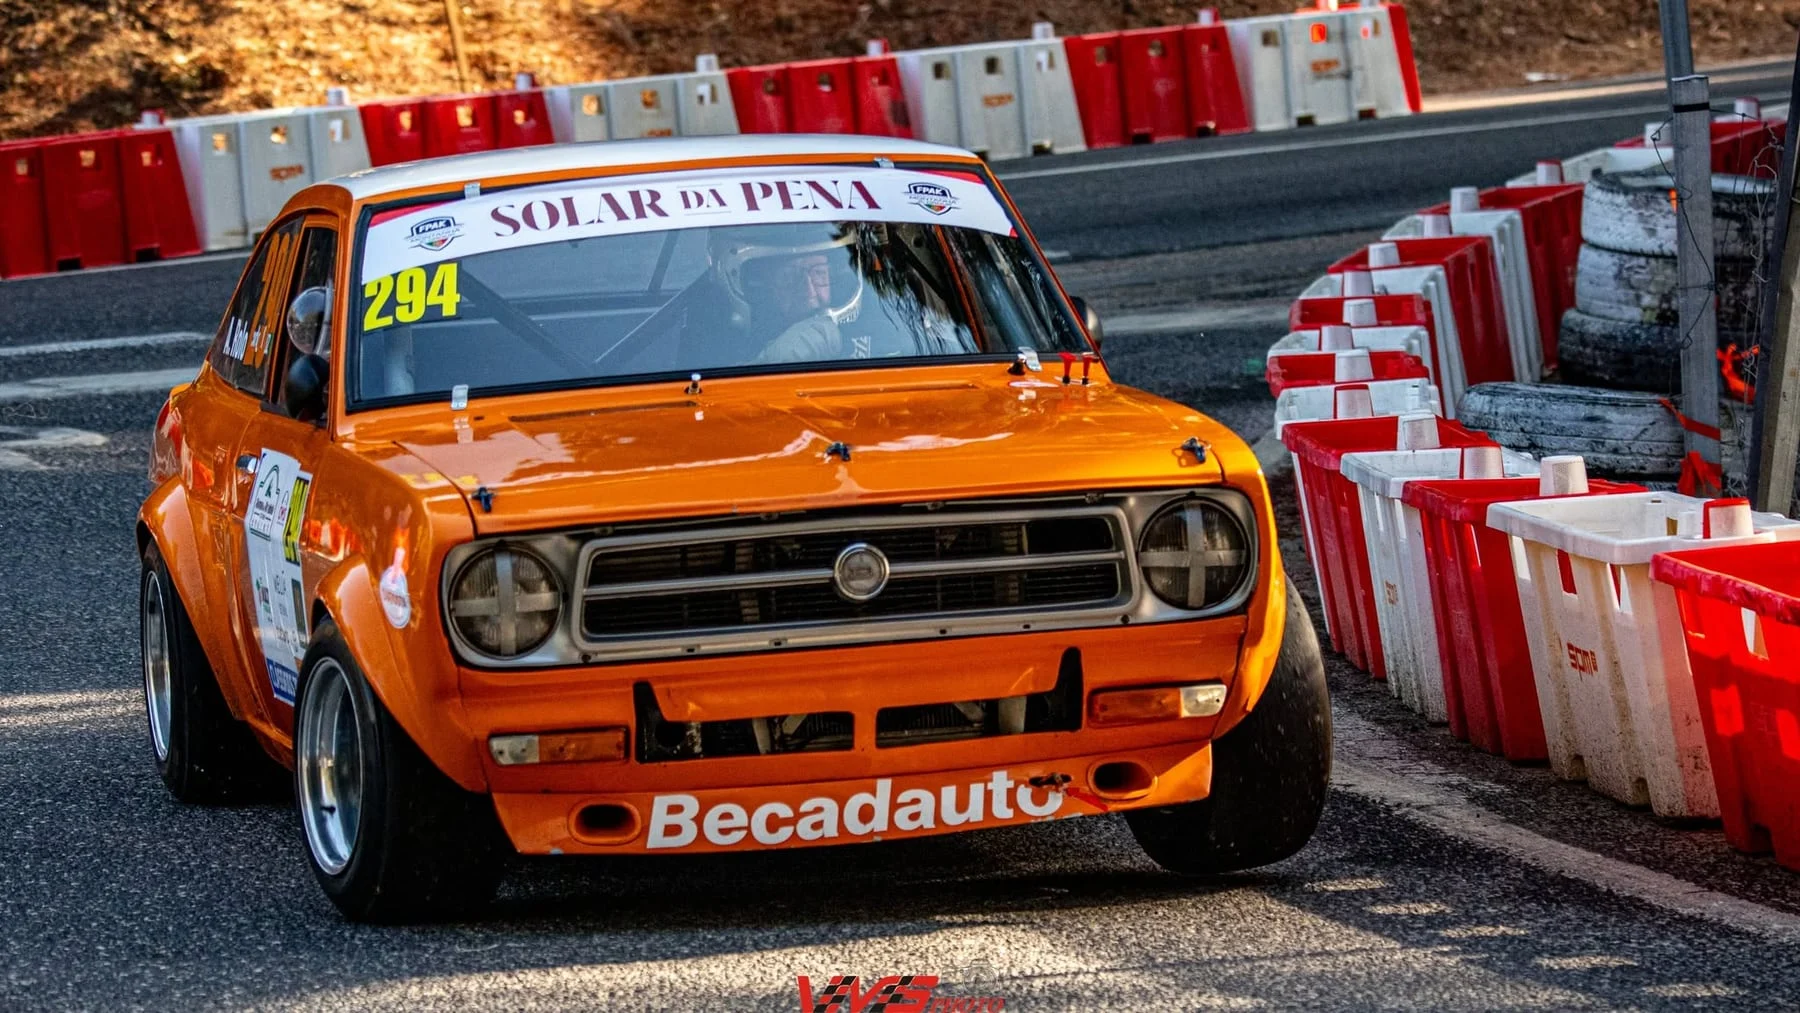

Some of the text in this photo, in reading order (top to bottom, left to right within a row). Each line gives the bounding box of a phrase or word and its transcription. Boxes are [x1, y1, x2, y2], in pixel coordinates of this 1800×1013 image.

[490, 180, 882, 238] SOLAR DA PENA
[916, 186, 944, 197] FPAK
[418, 220, 447, 233] FPAK
[363, 262, 461, 332] 294
[646, 770, 1064, 849] Becadauto
